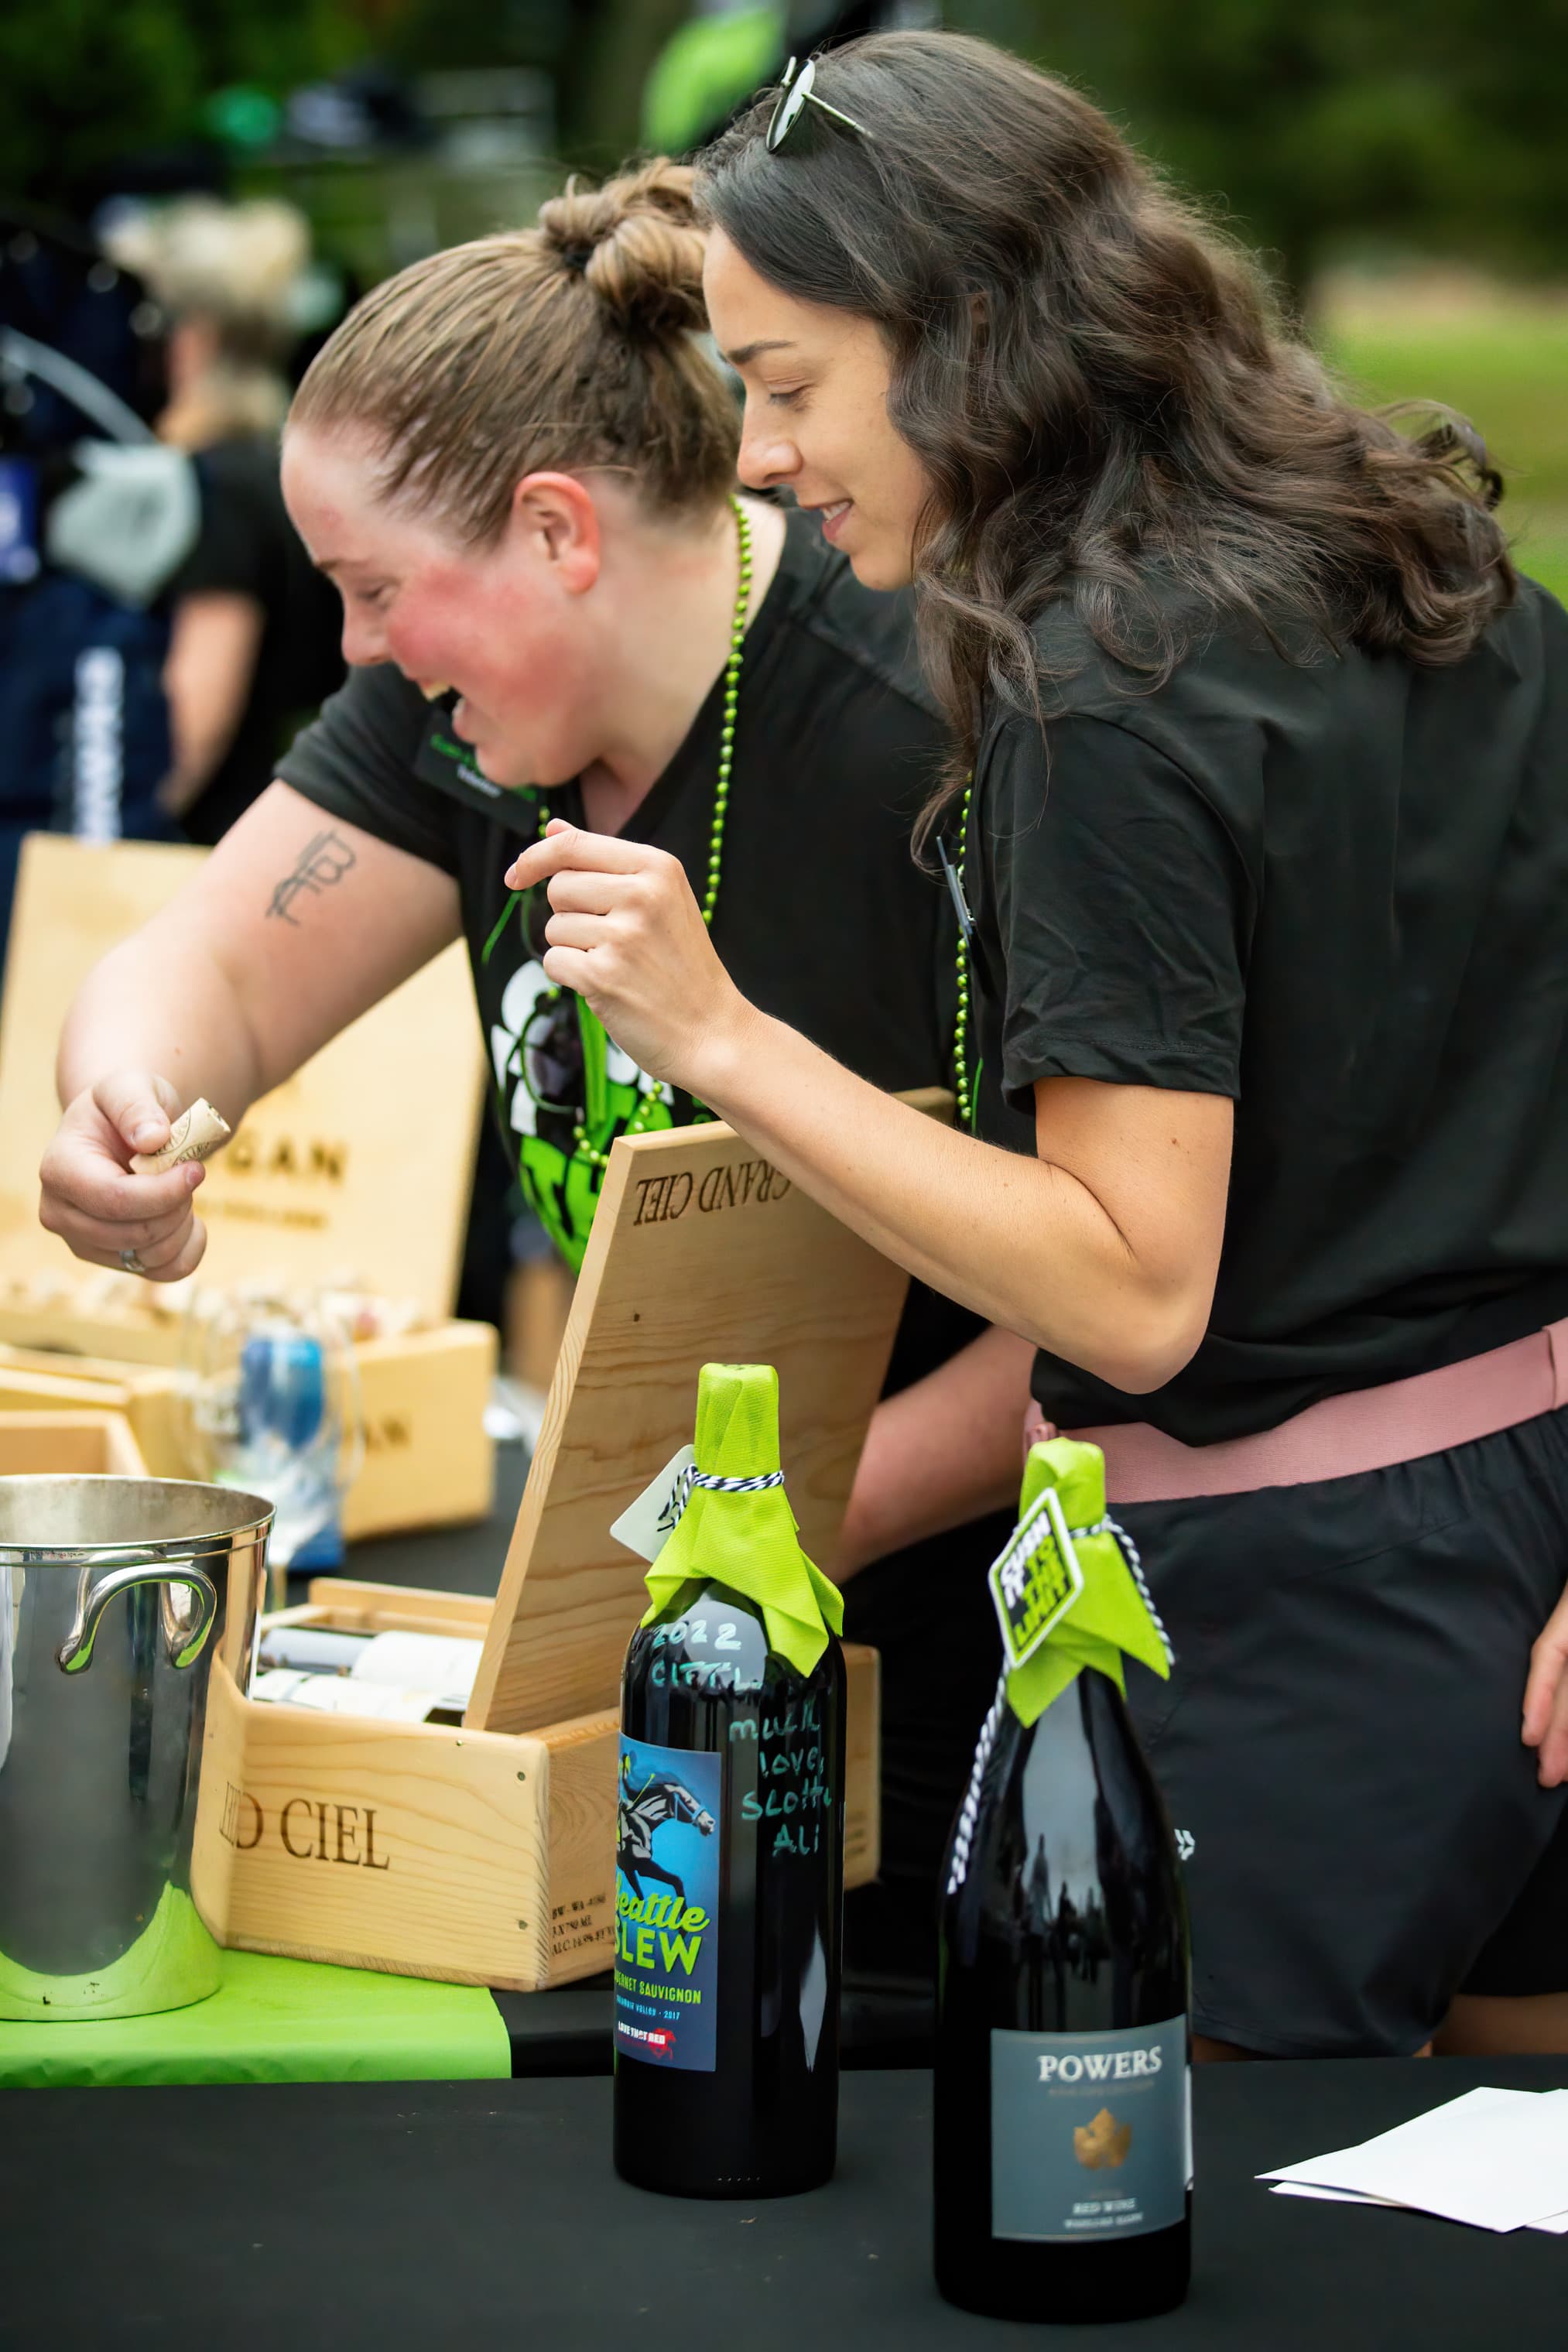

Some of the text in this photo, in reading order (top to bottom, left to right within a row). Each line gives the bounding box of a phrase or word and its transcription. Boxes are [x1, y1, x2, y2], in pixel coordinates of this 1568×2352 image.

[632, 1171, 693, 1226] CIEL
[651, 1619, 742, 1650] 2022
[280, 1798, 390, 1870] CIEL
[640, 1981, 702, 2005] SAUVIGNON
[1037, 2045, 1162, 2082] POWERS
